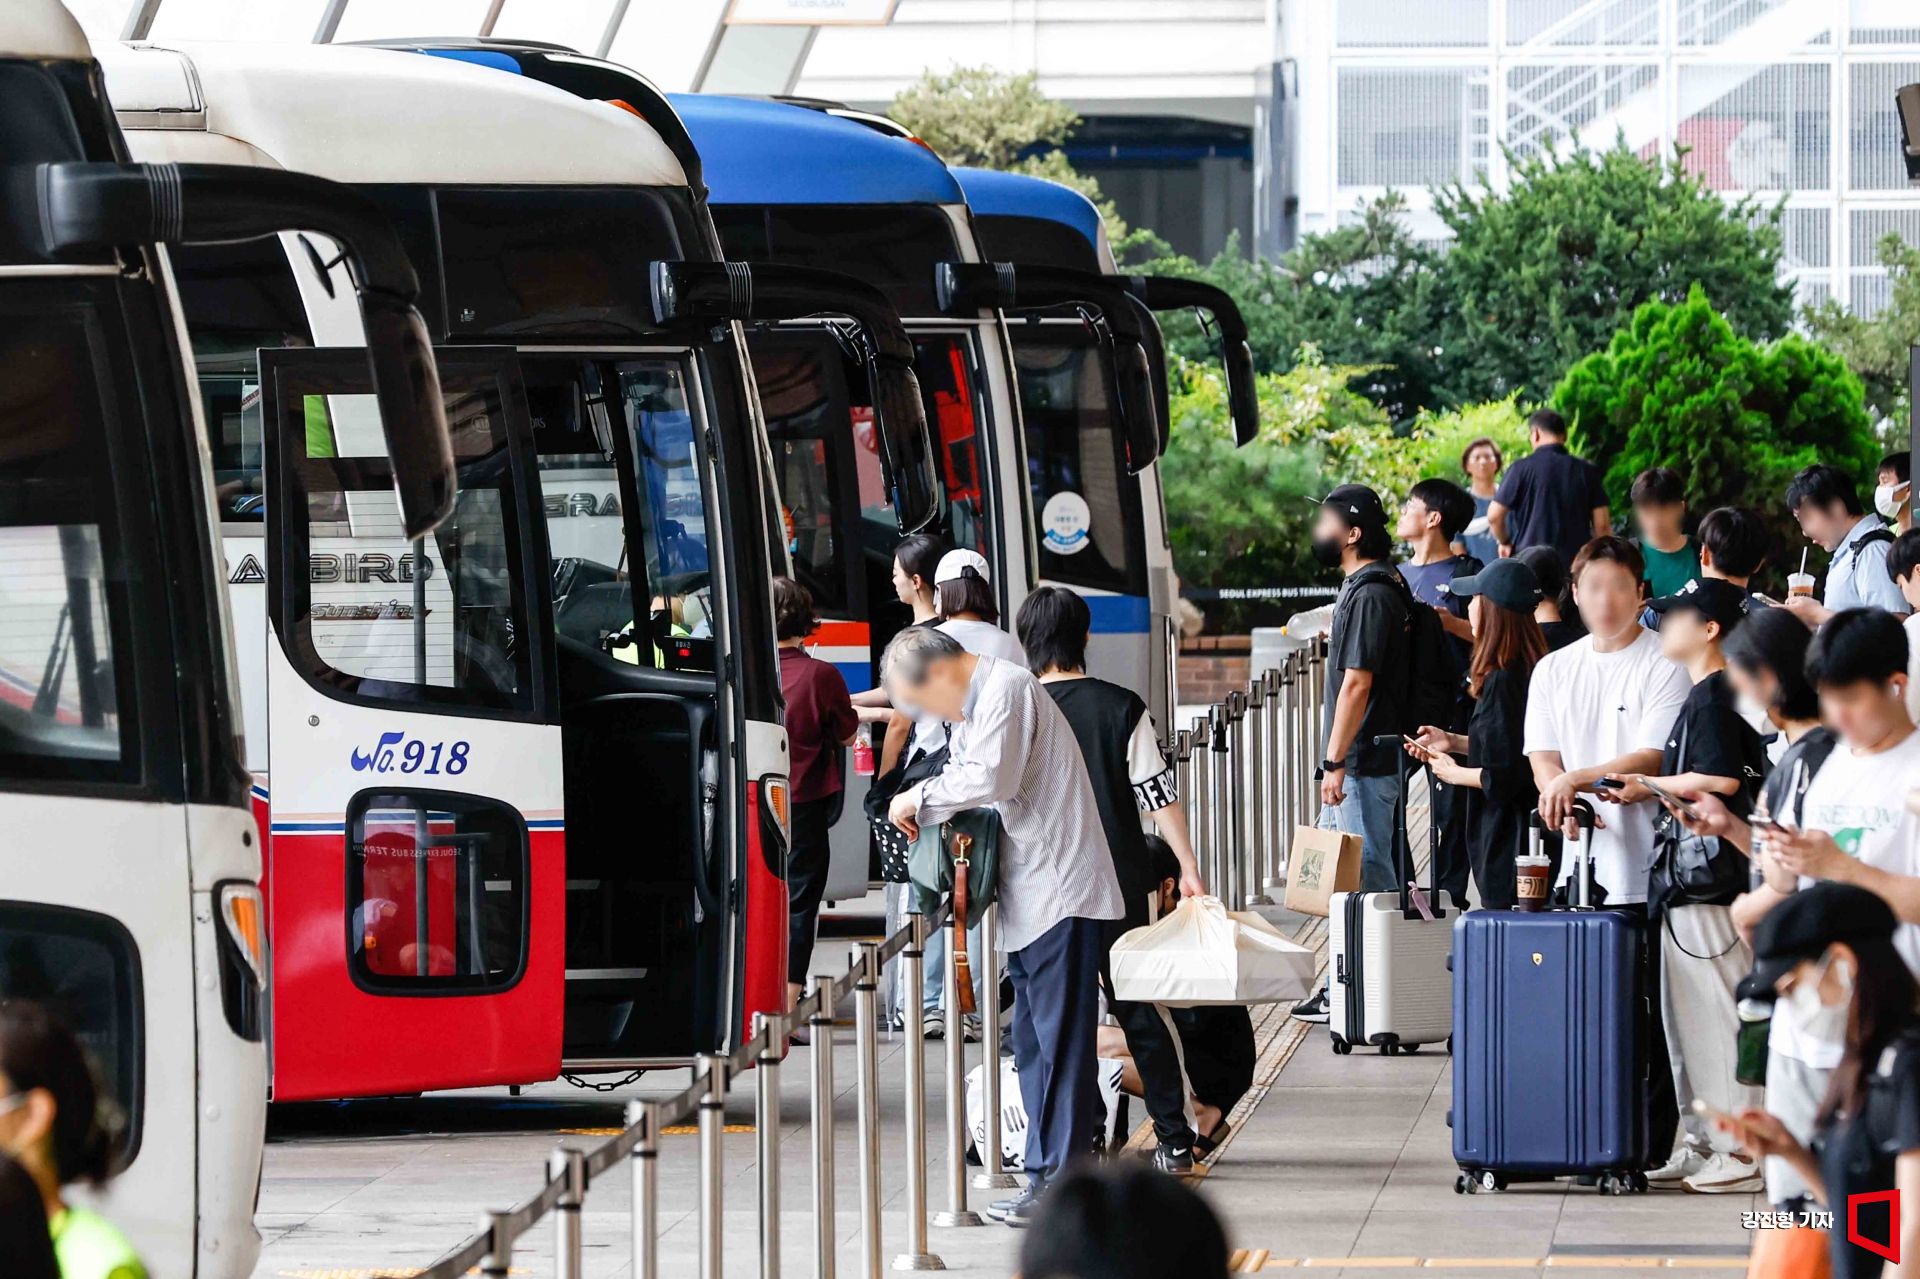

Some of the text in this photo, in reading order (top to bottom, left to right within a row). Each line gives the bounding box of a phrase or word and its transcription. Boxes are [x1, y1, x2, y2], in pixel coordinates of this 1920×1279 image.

[1219, 588, 1245, 599] SEOUL
[1246, 588, 1281, 599] EXPRESS
[1282, 587, 1298, 598] BUS
